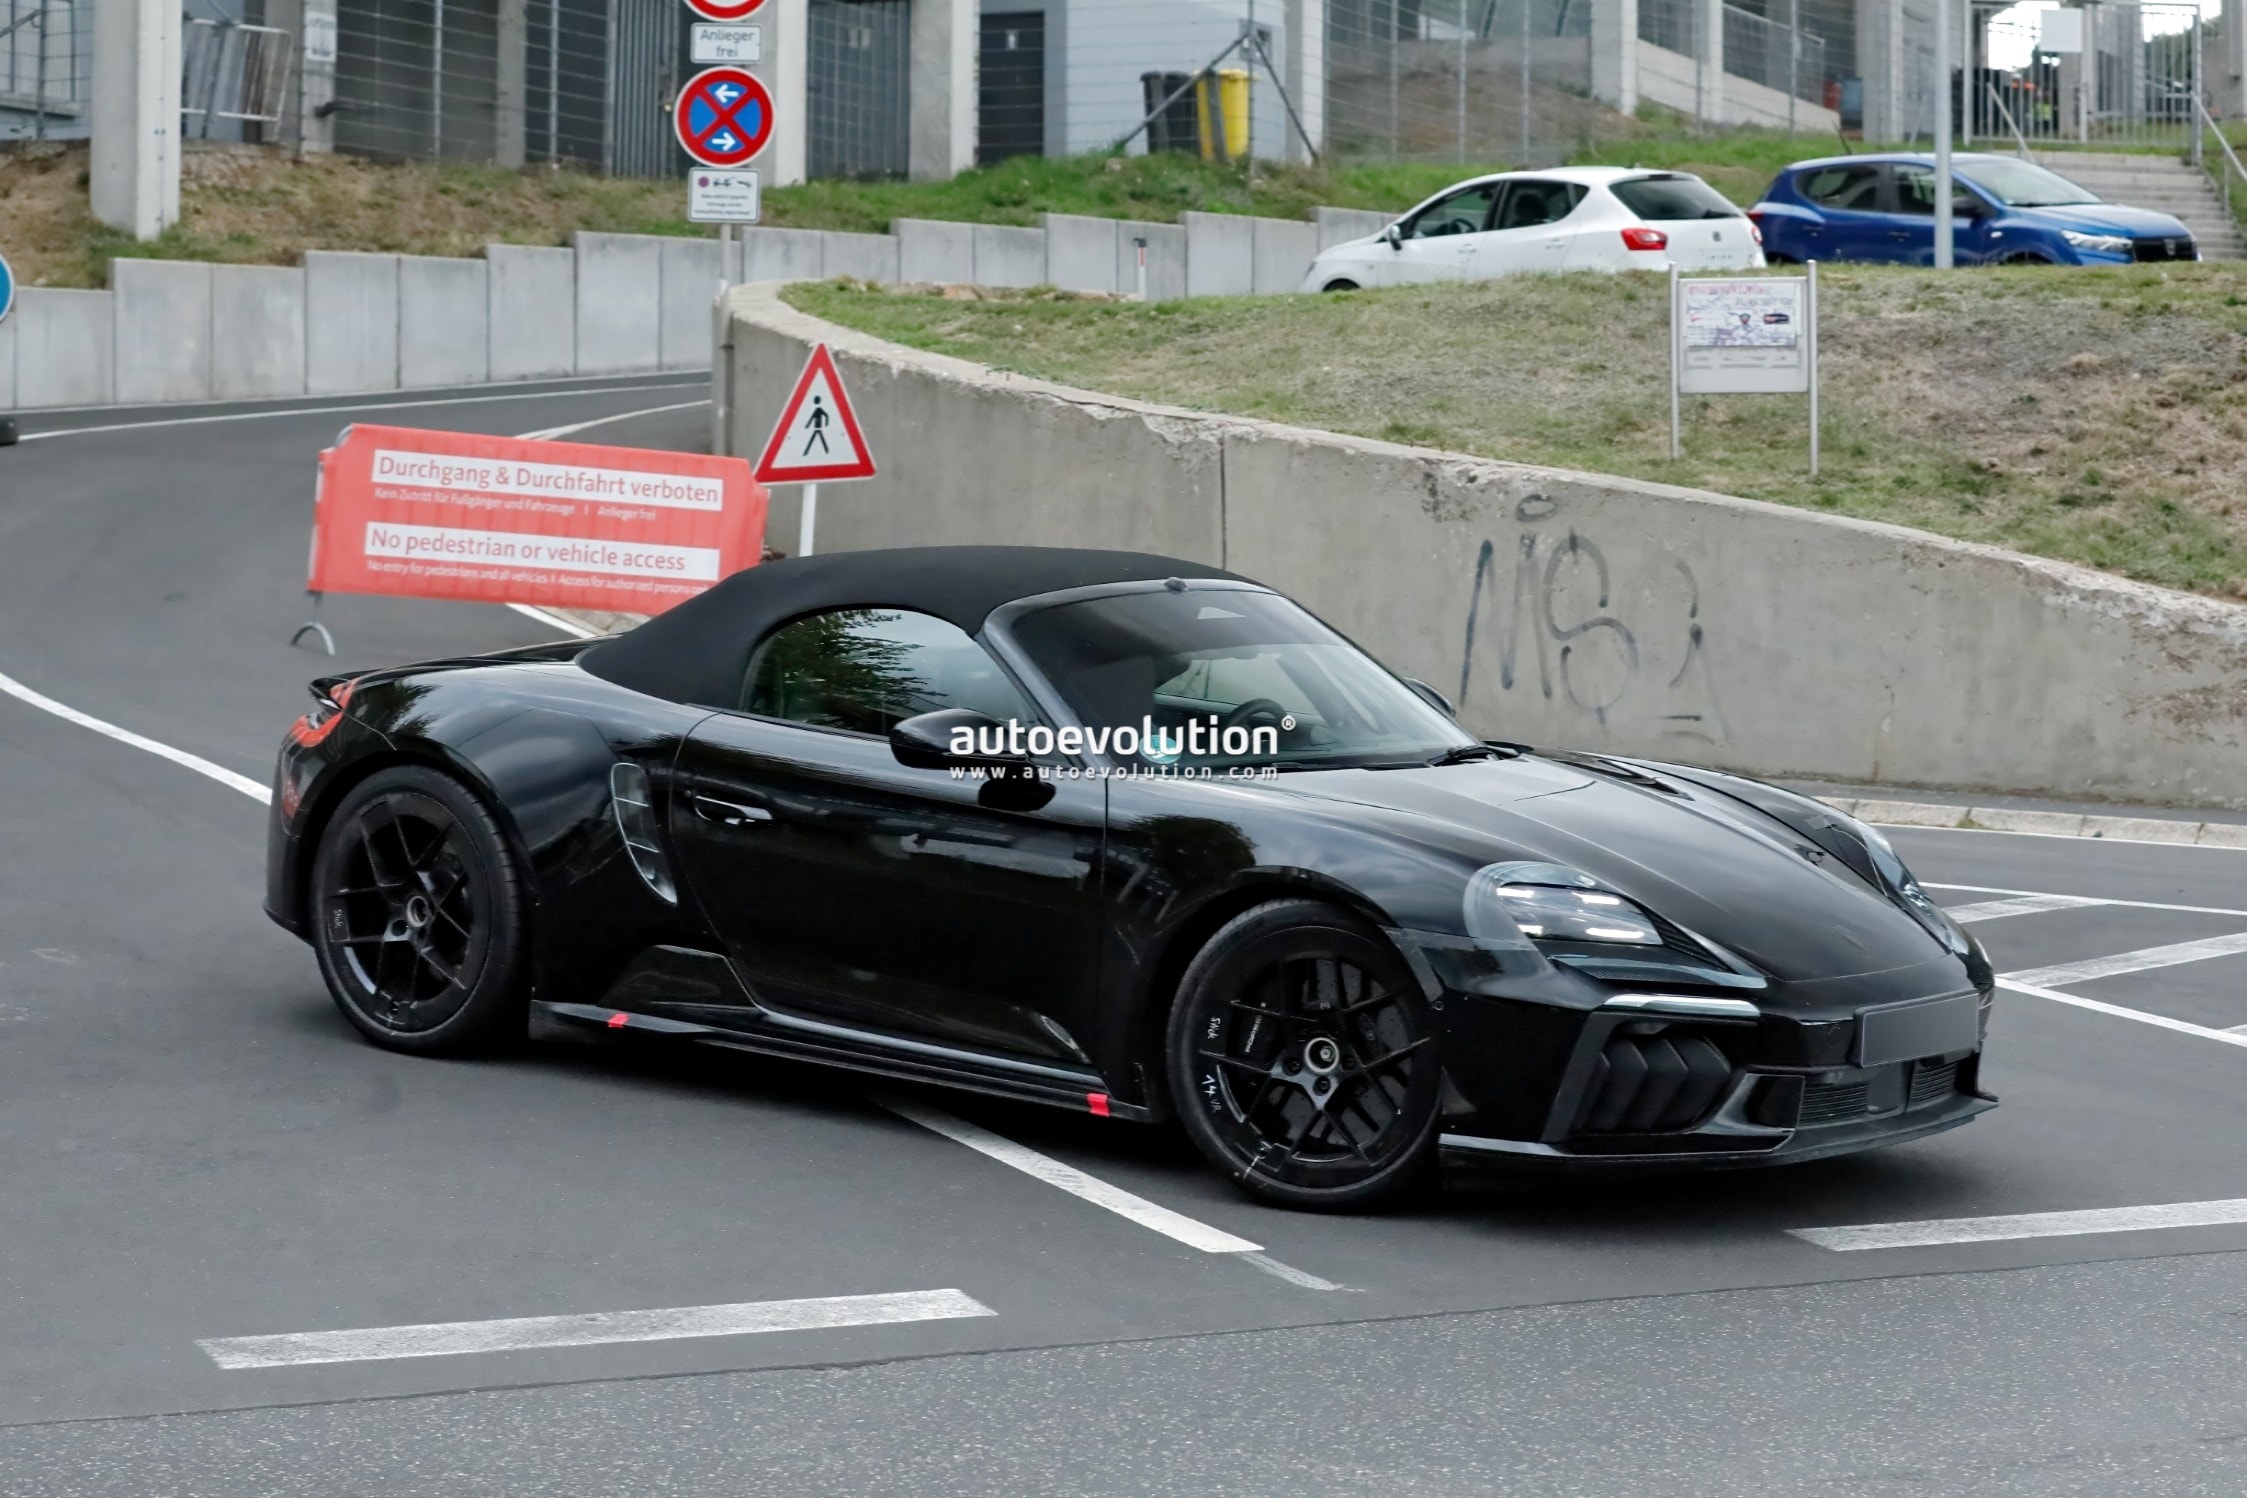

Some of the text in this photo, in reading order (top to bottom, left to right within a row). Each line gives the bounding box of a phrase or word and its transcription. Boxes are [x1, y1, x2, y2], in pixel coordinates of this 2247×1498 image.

[700, 29, 754, 43] Anlieger
[715, 45, 738, 57] frei
[378, 456, 719, 503] Durchgang & Durchfahrt verboten
[371, 529, 686, 570] No pedestrian or vehicle access
